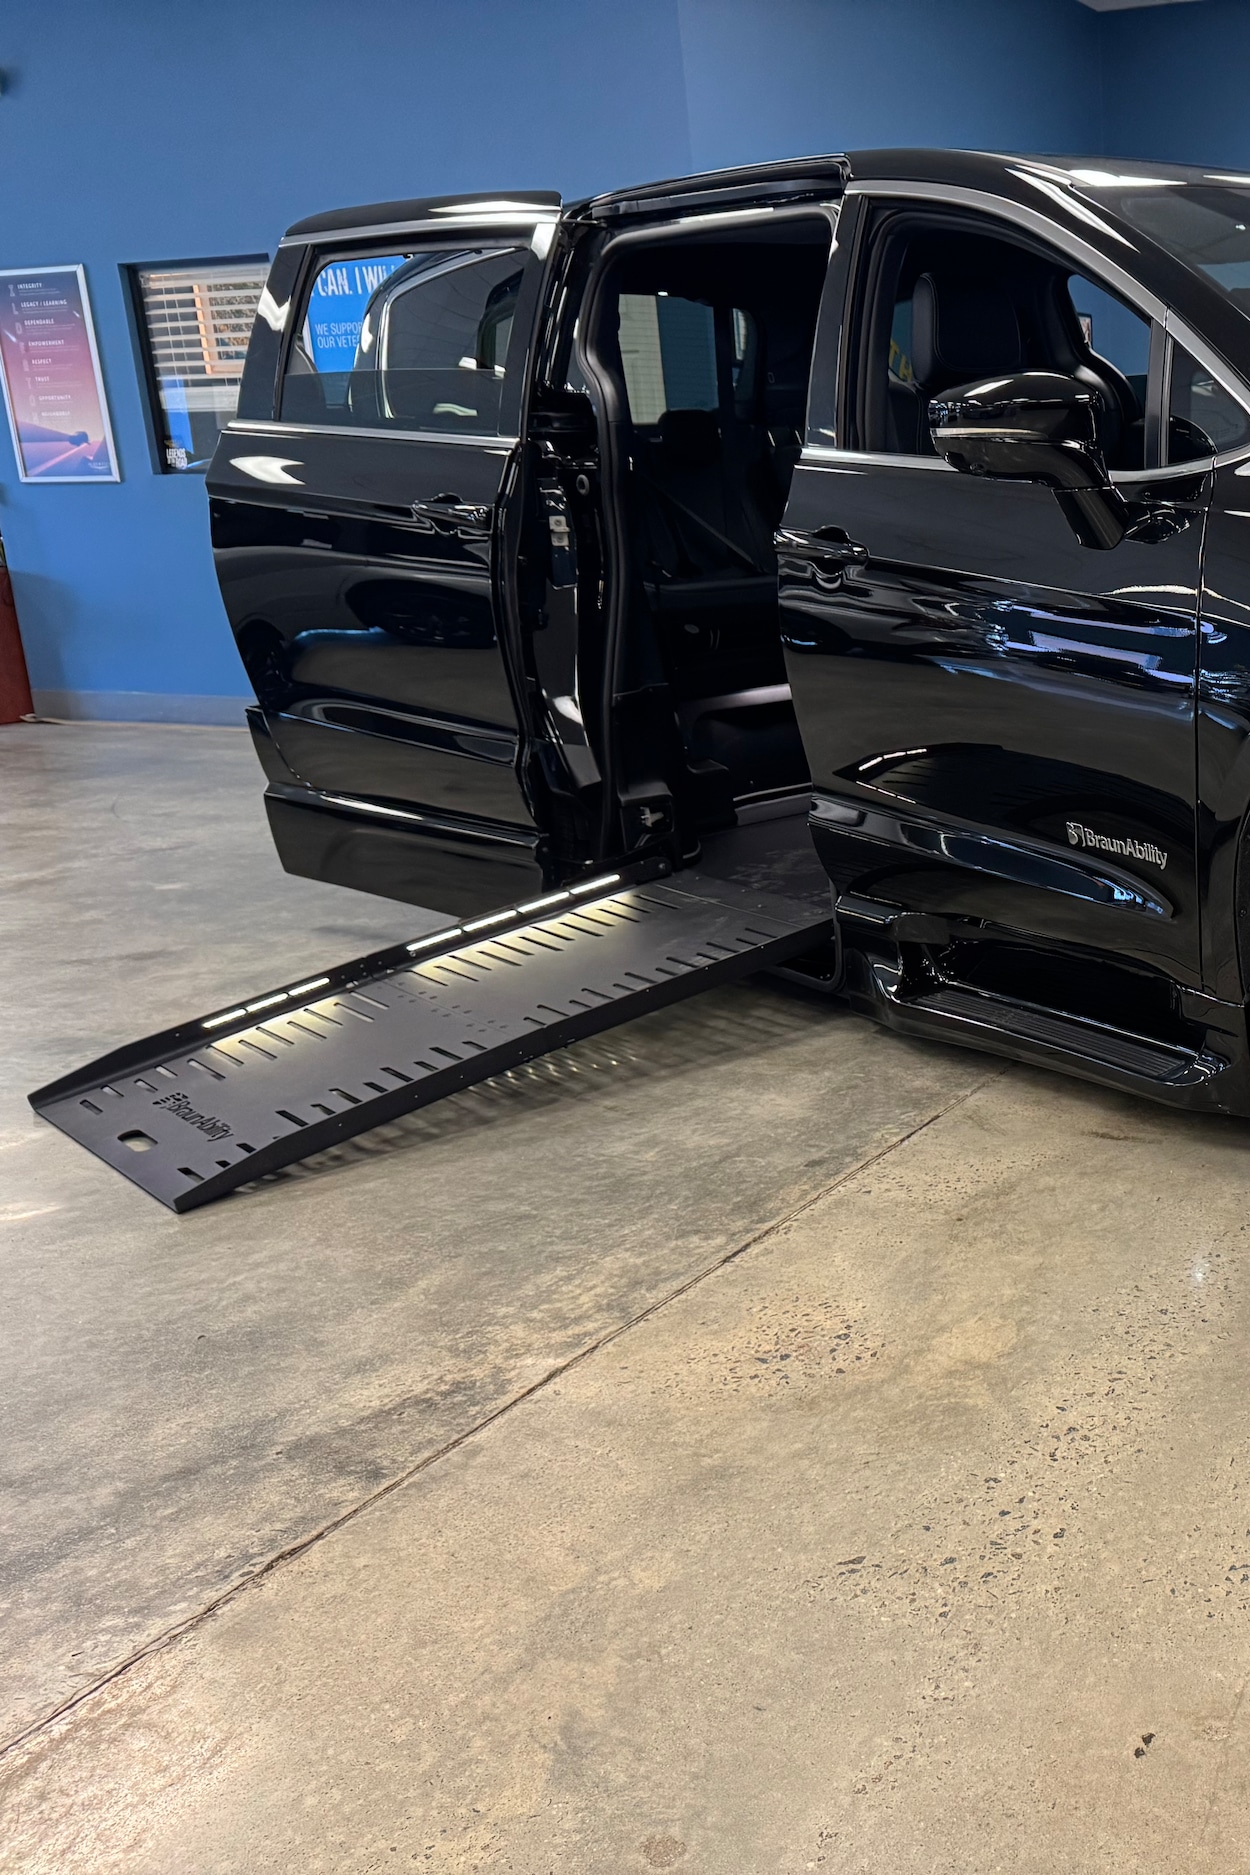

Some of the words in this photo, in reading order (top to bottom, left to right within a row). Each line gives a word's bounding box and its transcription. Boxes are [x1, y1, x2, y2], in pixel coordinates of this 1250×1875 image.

[362, 265, 394, 294] WI
[43, 299, 68, 307] LEARNING
[24, 318, 55, 326] DEPENDABLE
[315, 323, 329, 335] WE
[28, 339, 65, 347] EMPOWERMENT
[317, 335, 336, 348] OUR
[1084, 827, 1168, 870] BraunAbility
[166, 1100, 235, 1142] BraunAbility
